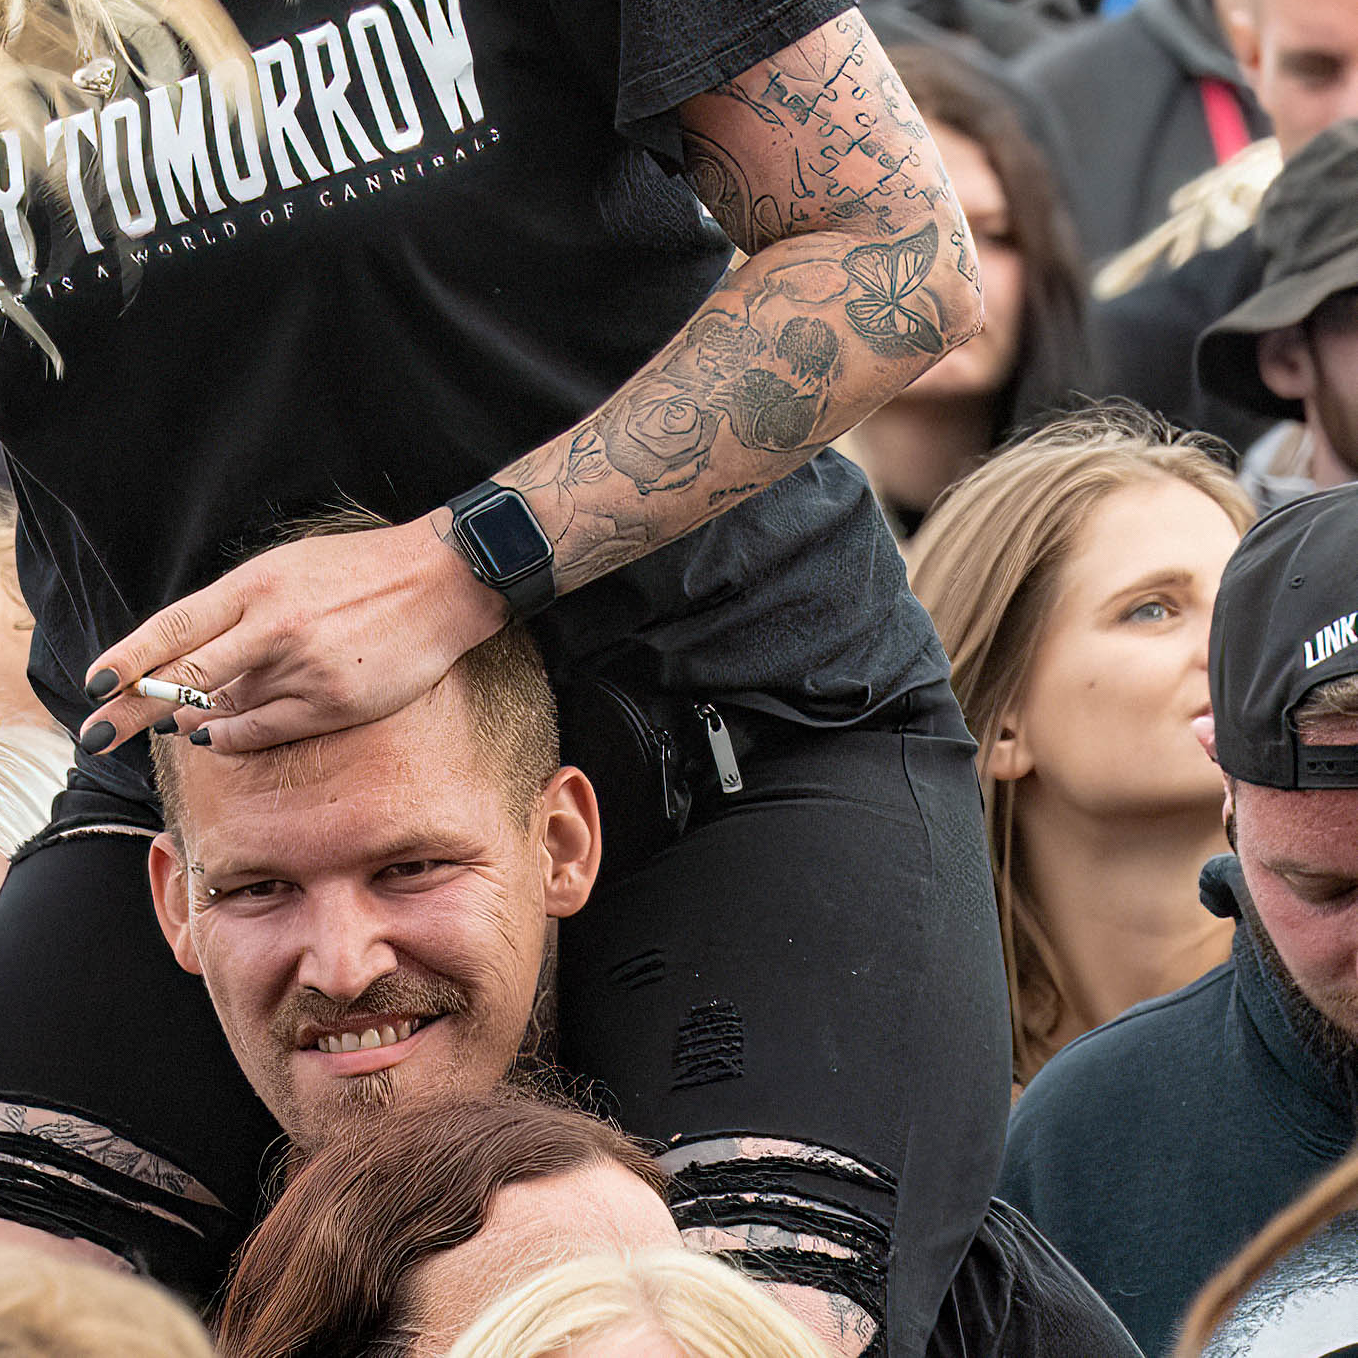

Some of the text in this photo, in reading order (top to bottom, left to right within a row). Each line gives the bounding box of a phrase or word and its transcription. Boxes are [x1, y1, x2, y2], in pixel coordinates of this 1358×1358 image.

[129, 221, 238, 267] WORLD
[260, 201, 295, 227] OF
[318, 127, 502, 208] CANNIBALS
[1303, 610, 1358, 670] LINK
